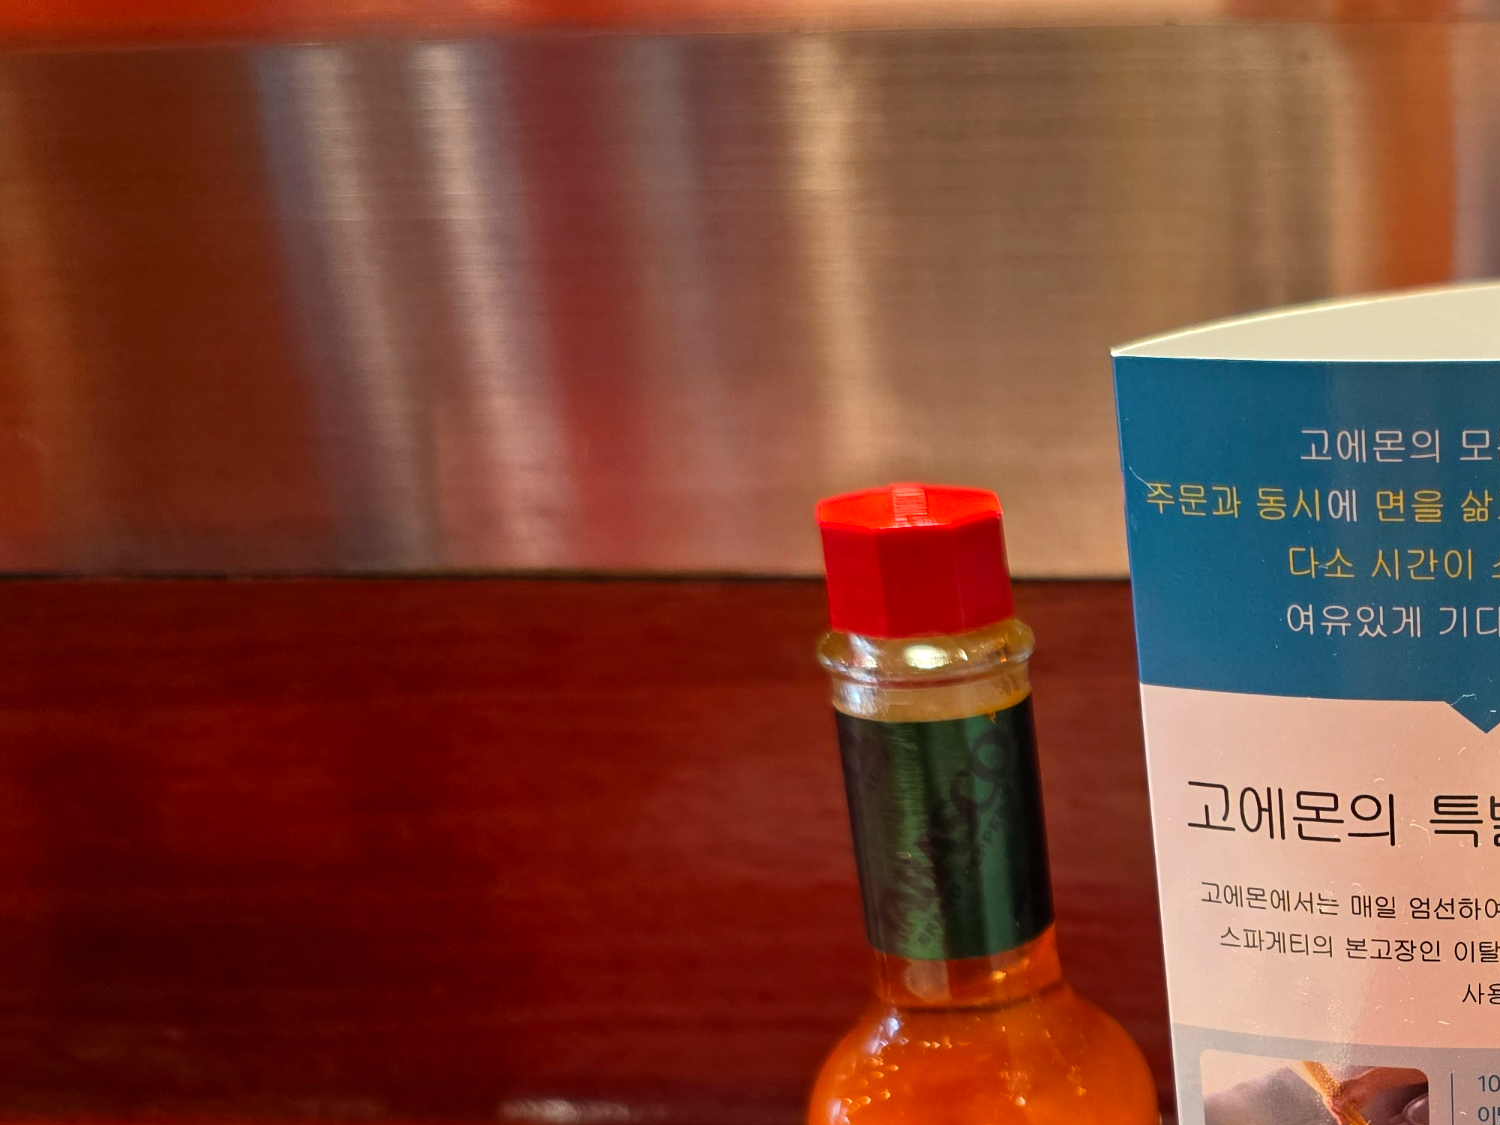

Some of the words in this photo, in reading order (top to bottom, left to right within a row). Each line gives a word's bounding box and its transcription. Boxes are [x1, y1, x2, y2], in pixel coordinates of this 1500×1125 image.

[1301, 429, 1439, 463] 고에몬의
[1145, 477, 1241, 518] 주문과
[1257, 488, 1357, 522] 동시에
[1377, 489, 1443, 522] 면을
[1289, 547, 1355, 578] 다소
[1372, 549, 1472, 580] 시간이
[1287, 604, 1420, 637] 여유있게
[1188, 781, 1395, 846] 고에몬의
[1201, 882, 1339, 915] 고에몬에서는
[1351, 895, 1396, 918] 매일
[1221, 927, 1332, 957] 스파게티의
[1346, 938, 1440, 962] 본고장인
